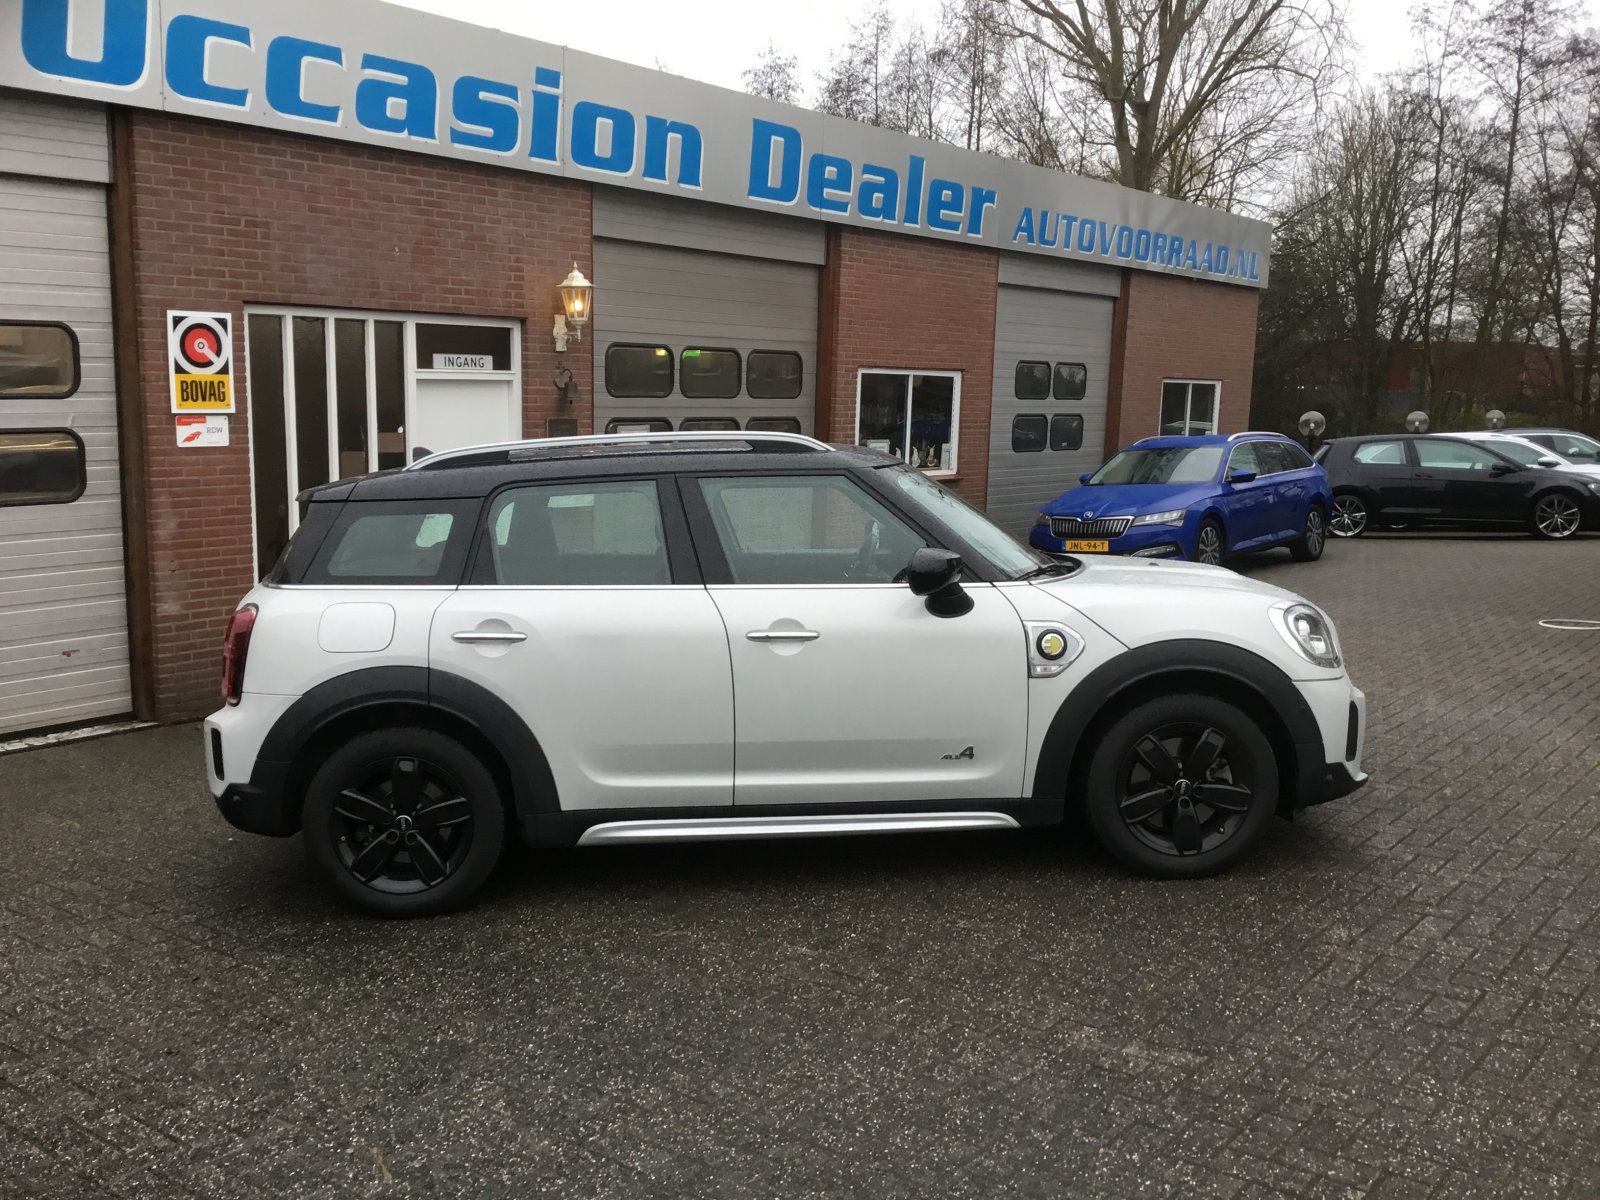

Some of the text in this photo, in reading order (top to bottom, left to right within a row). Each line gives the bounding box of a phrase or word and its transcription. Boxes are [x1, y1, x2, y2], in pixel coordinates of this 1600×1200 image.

[21, 0, 997, 238] Occasion Dealer
[1012, 207, 1260, 281] AUTOVOORRAAD.NL
[444, 356, 485, 368] INGANG
[180, 380, 226, 402] BOVAG
[1068, 541, 1106, 551] JNL-94-T
